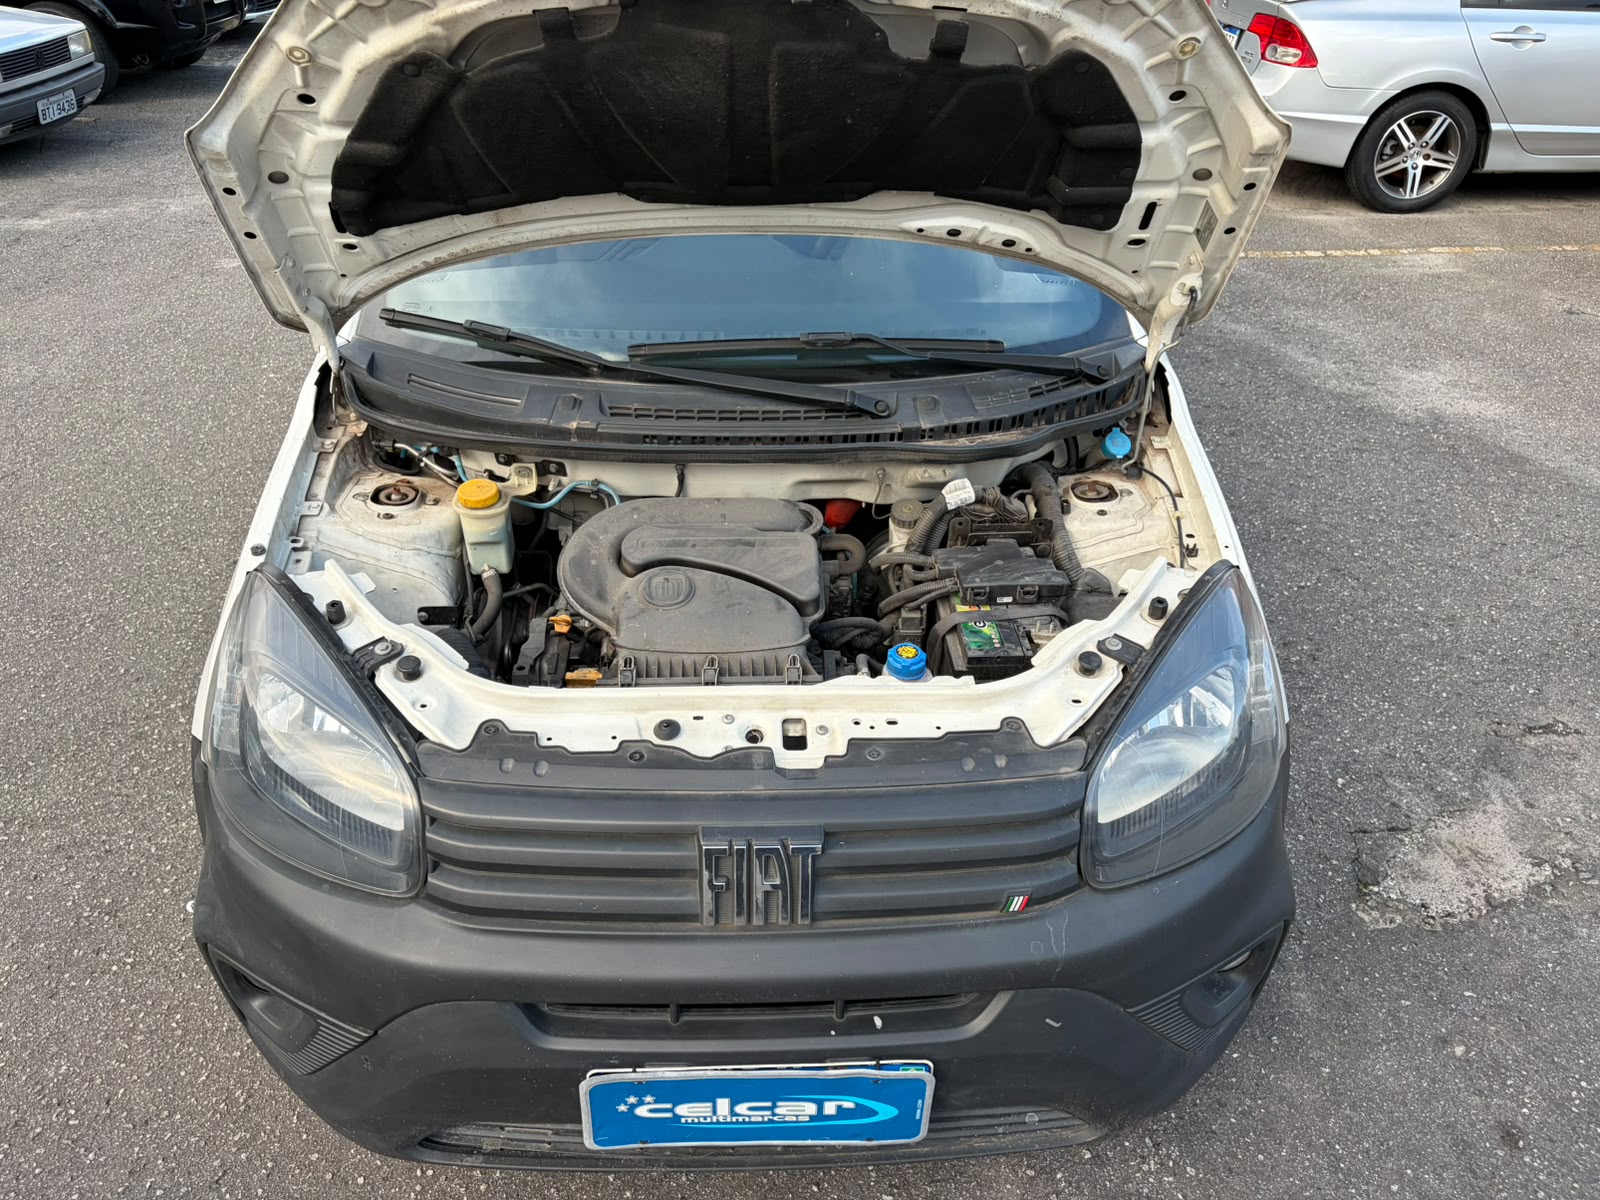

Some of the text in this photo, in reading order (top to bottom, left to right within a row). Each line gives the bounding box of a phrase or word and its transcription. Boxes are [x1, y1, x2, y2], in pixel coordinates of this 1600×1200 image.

[702, 844, 822, 926] FIAT
[634, 1097, 856, 1119] celcar
[682, 1115, 811, 1124] multimarcas
